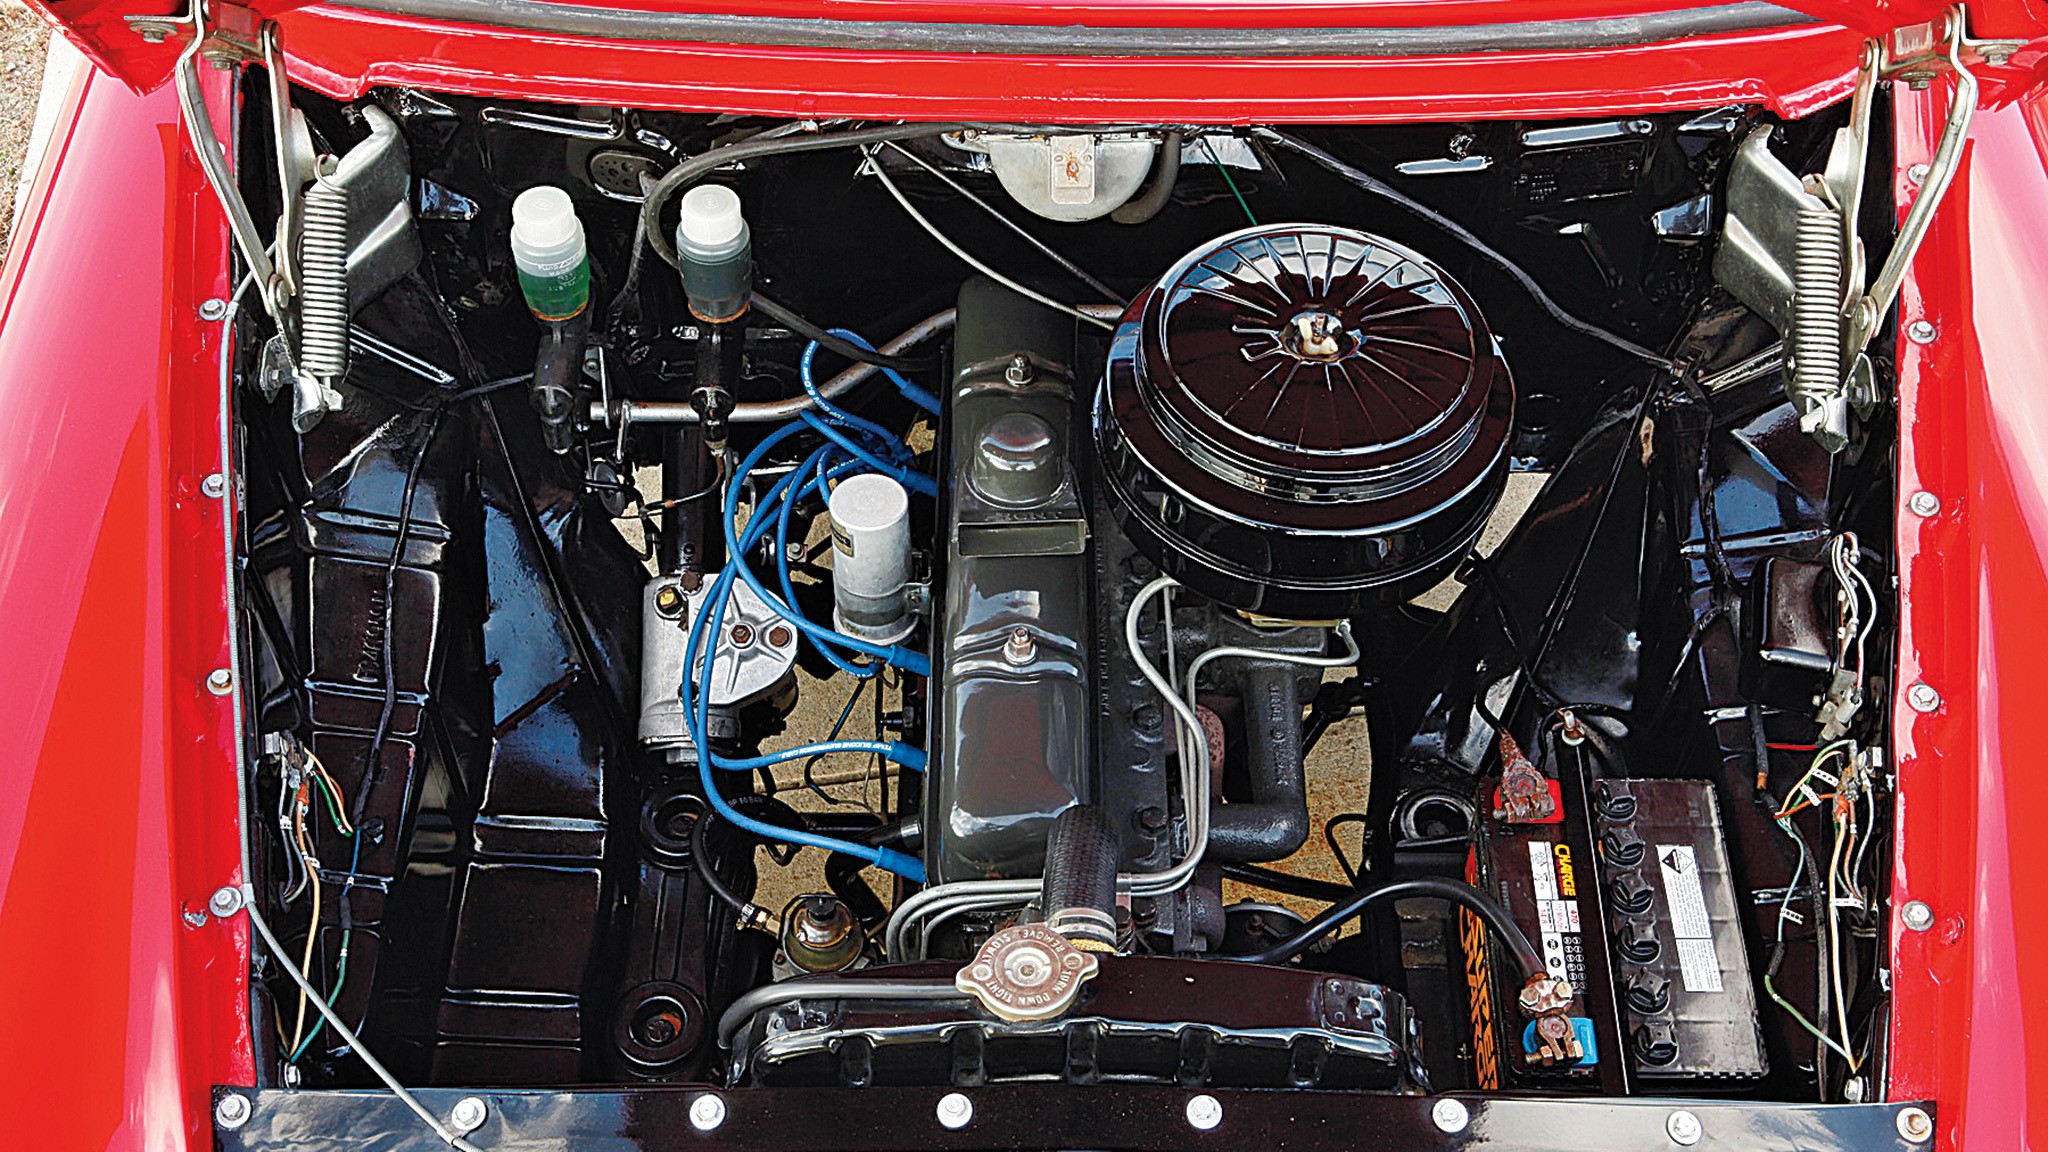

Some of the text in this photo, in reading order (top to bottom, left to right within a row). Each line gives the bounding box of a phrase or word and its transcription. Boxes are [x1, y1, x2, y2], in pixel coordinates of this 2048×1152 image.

[1554, 844, 1576, 897] CHARGE
[1570, 910, 1579, 924] 470
[981, 929, 1066, 966] REMOVE SLOWLY
[985, 969, 1073, 1006] TURN DOWN TIGHT
